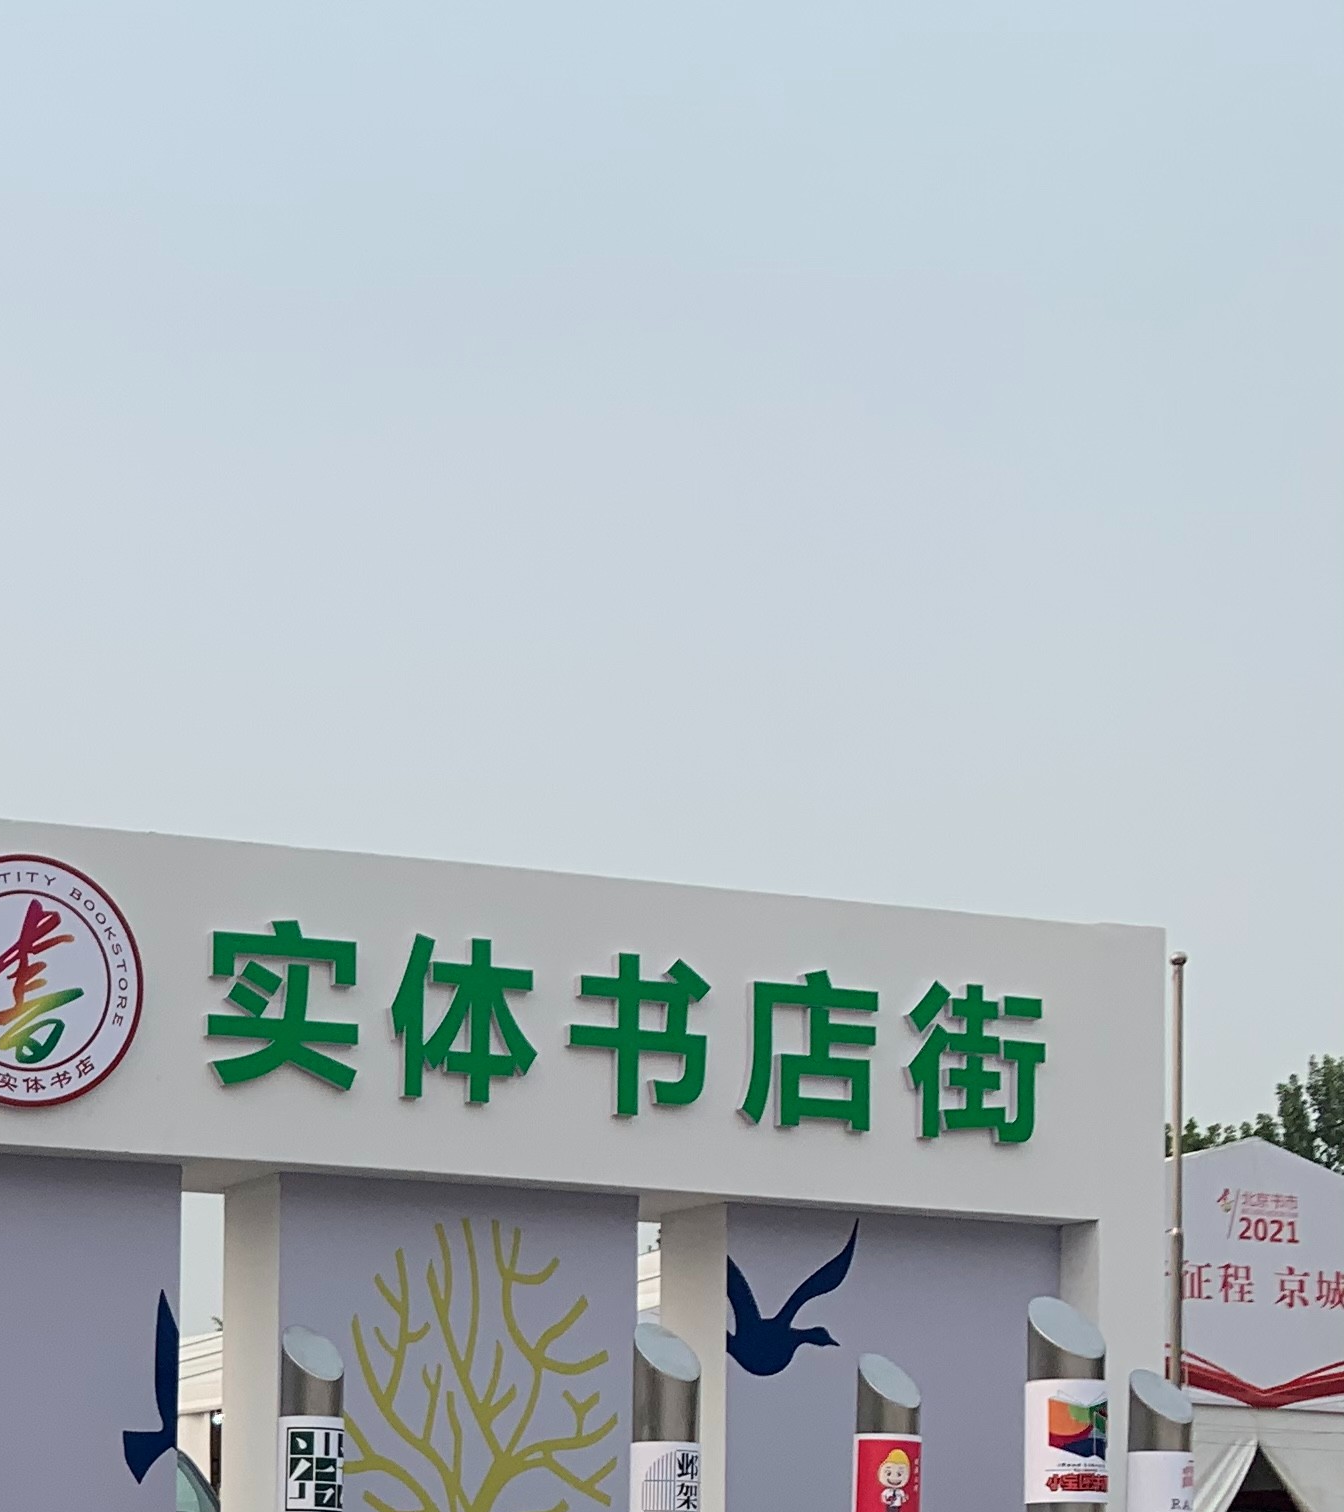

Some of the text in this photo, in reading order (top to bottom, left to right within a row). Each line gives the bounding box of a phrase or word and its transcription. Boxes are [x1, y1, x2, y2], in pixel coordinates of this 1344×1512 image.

[69, 887, 128, 1027] BOOKSTORE
[204, 919, 1048, 1144] 实体书店街
[1238, 1217, 1300, 1244] 2021
